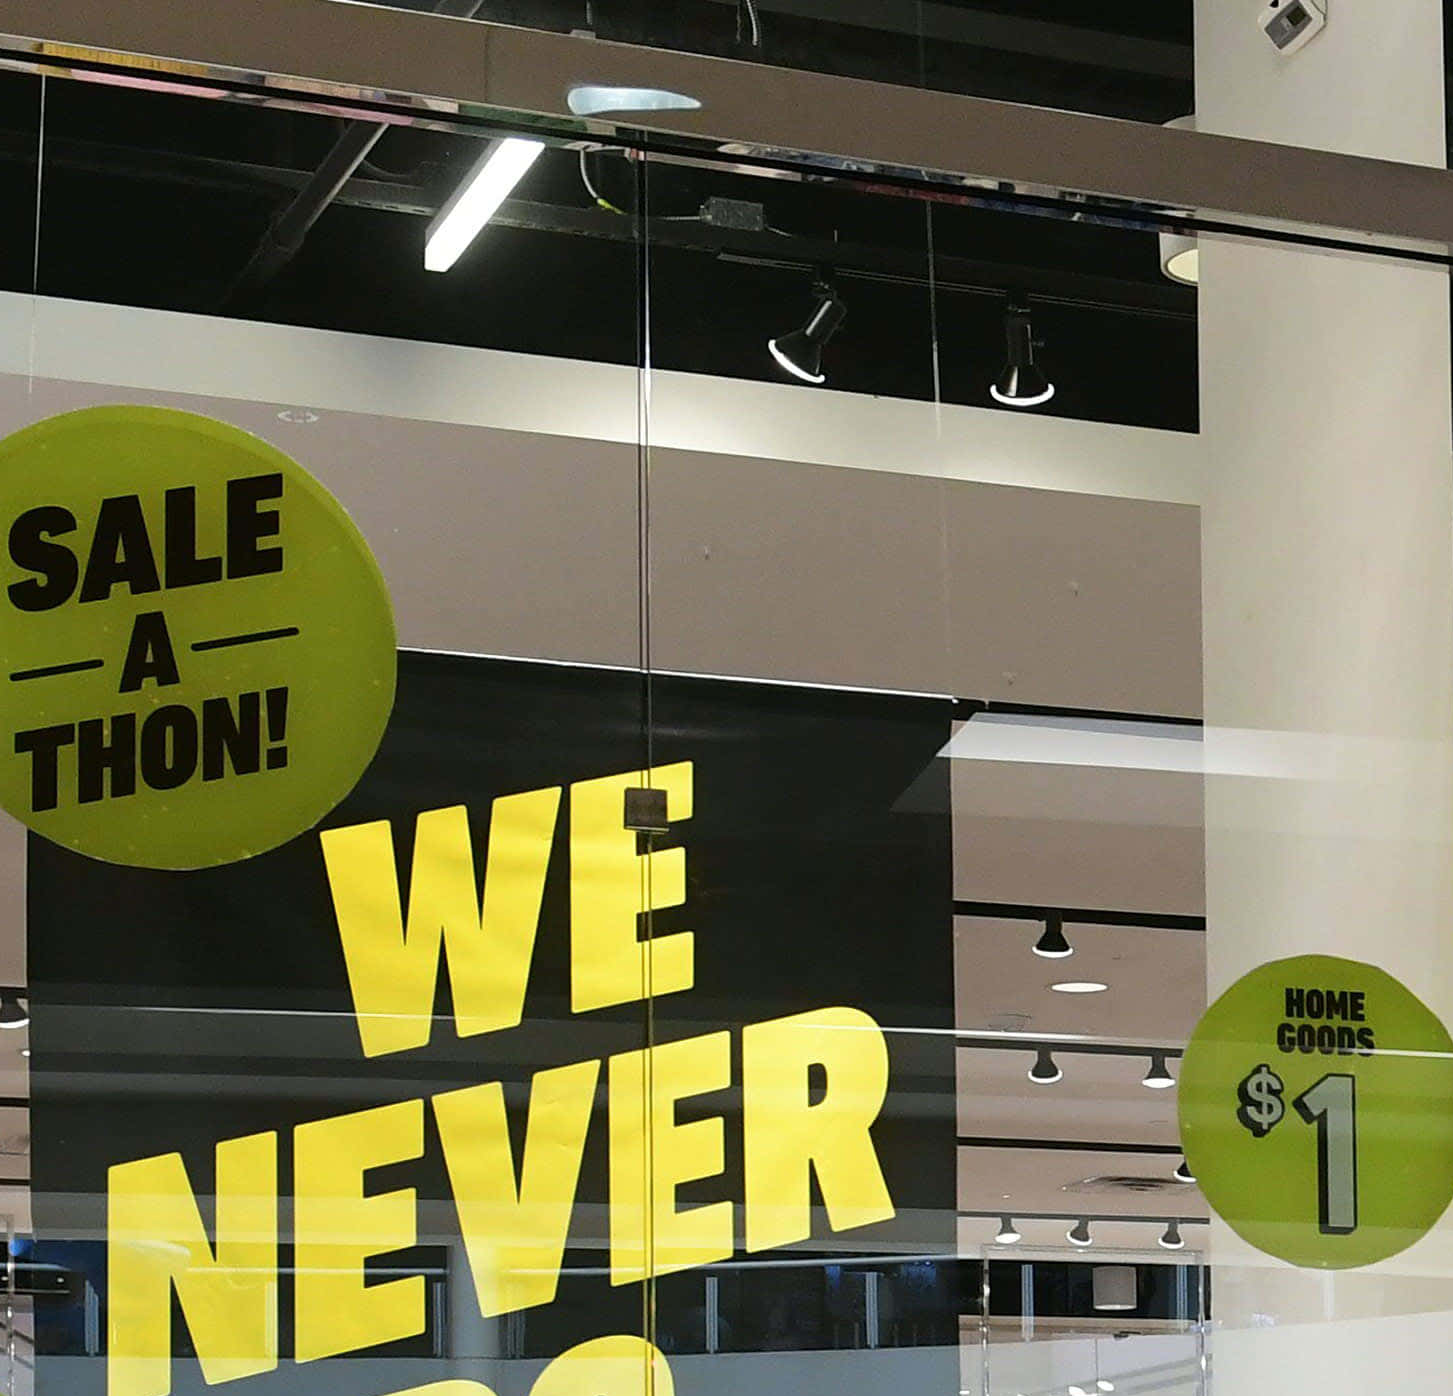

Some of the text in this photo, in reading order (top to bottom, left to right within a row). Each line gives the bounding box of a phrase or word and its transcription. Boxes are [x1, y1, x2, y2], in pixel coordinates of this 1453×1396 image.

[7, 473, 284, 611] SALE
[118, 611, 179, 693] A
[14, 687, 290, 813] THON!
[320, 760, 694, 1059] WE
[1277, 1022, 1375, 1057] GOODS
[1285, 987, 1366, 1022] HOME
[1237, 1063, 1358, 1236] $1
